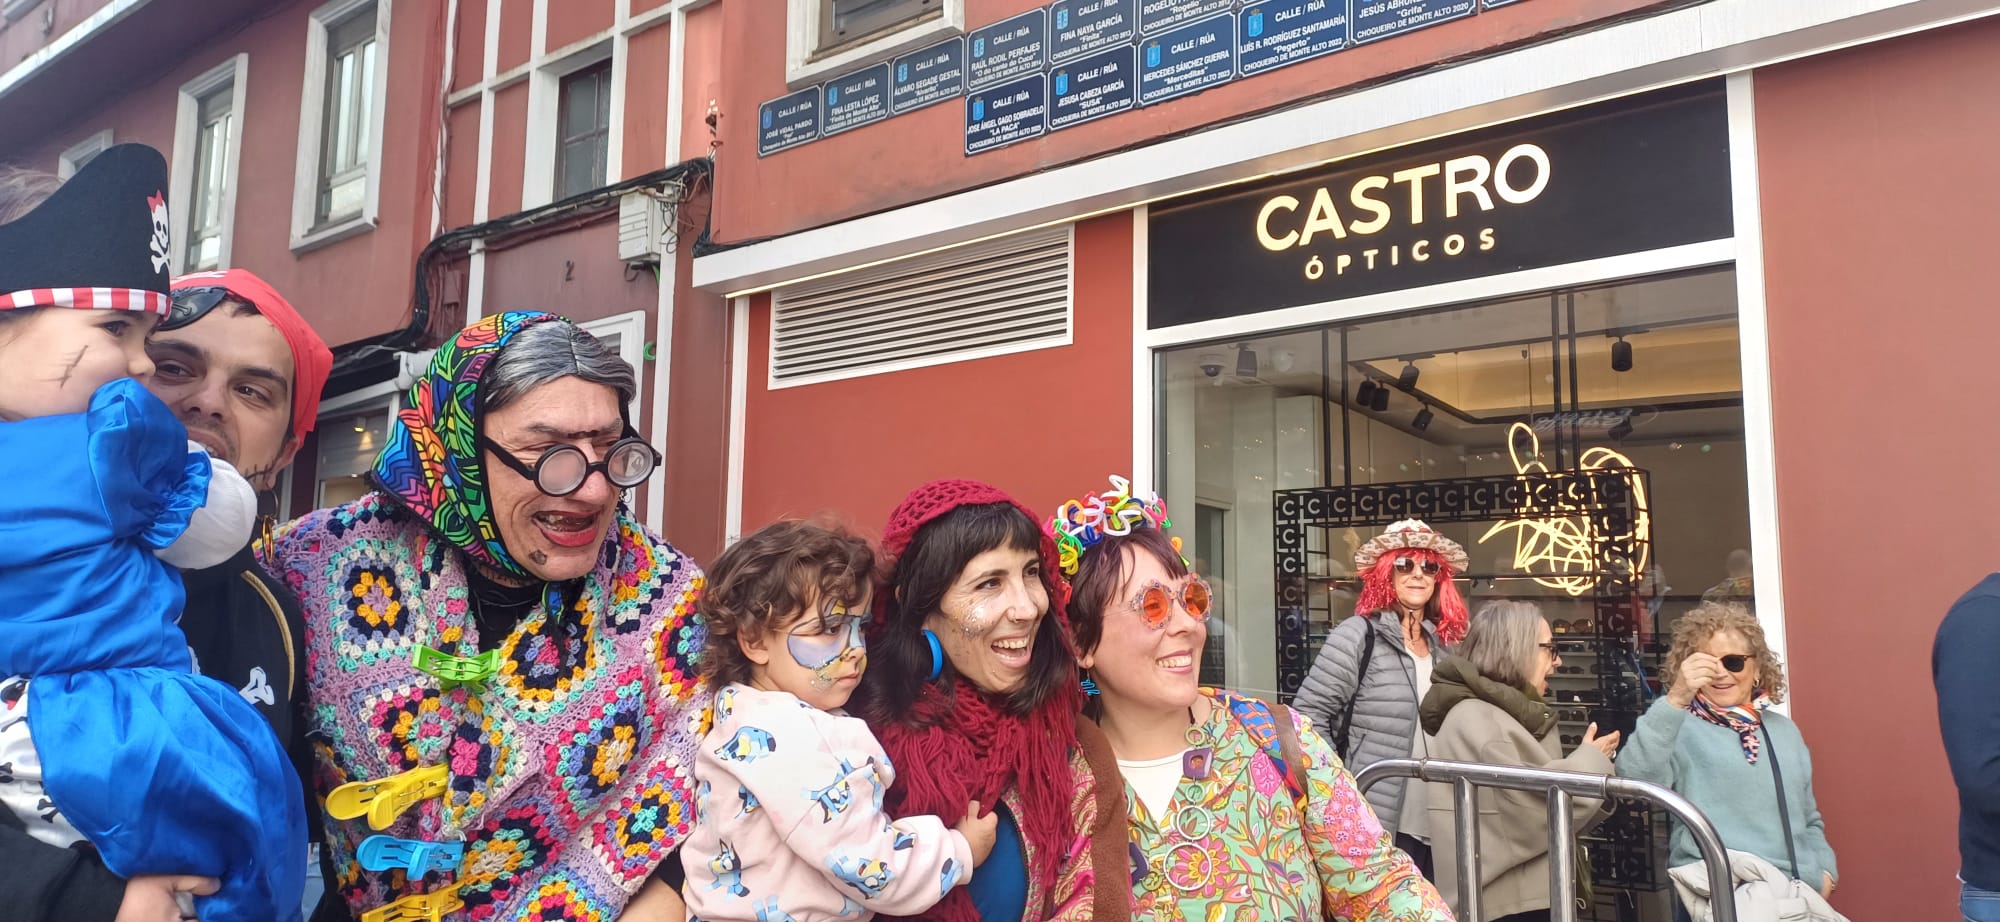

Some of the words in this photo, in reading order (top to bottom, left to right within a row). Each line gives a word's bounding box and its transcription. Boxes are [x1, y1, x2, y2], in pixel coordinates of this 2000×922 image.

[1078, 4, 1100, 16] CALLE
[1184, 7, 1202, 18] MONTE
[1203, 2, 1217, 11] ALTO
[1275, 7, 1301, 22] CALLE
[1359, 2, 1385, 18] JESÚS
[1396, 3, 1426, 17] "Grifa"
[1060, 31, 1076, 42] FINA
[1077, 24, 1095, 36] NAYA
[1096, 13, 1122, 30] GARCÍA
[1357, 22, 1396, 38] CHOQUEIRO
[1398, 18, 1407, 28] DE
[1408, 12, 1432, 24] MONTE
[1434, 8, 1452, 18] ALTO
[1453, 2, 1469, 13] 2020
[993, 32, 1012, 45] CALLE
[1017, 26, 1030, 37] RÚA
[1256, 40, 1262, 48] R.
[1263, 28, 1301, 46] RODRÍGUEZ
[1302, 14, 1345, 35] SANTAMARÍA
[1089, 38, 1105, 48] MONTE
[1107, 34, 1119, 42] ALTO
[1171, 39, 1194, 54] CALLE
[1200, 32, 1215, 45] RÚA
[1273, 37, 1310, 54] "Pegerto"
[916, 59, 933, 71] CALLE
[937, 53, 949, 64] RÚA
[971, 58, 987, 71] RAÚL
[989, 53, 1007, 65] RODIL
[1008, 42, 1040, 59] PERFAJES
[1244, 56, 1278, 71] CHOQUEIRO
[1280, 53, 1288, 61] DE
[1289, 46, 1310, 58] MONTE
[1312, 42, 1327, 52] ALTO
[1328, 38, 1342, 48] 2022
[1003, 66, 1018, 76] MONTE
[1019, 62, 1030, 71] ALTO
[1078, 68, 1098, 82] CALLE
[1104, 62, 1118, 74] RÚA
[1144, 66, 1175, 82] MERCEDES
[1176, 57, 1203, 72] SÁNCHEZ
[1204, 50, 1229, 64] GUERRA
[939, 69, 960, 81] GESTAL
[845, 85, 861, 94] CALLE
[865, 78, 876, 88] RÚA
[940, 88, 950, 96] ALTO
[1058, 94, 1079, 107] JESUSA
[1080, 87, 1102, 100] CABEZA
[1103, 79, 1124, 94] GARCÍA
[1143, 86, 1174, 100] CHOQUEIRA
[1183, 76, 1202, 88] MONTE
[1203, 73, 1217, 82] ALTO
[832, 106, 844, 116] FINA
[844, 100, 860, 112] LESTA
[861, 94, 879, 106] LÓPEZ
[993, 96, 1011, 109] CALLE
[1016, 90, 1029, 102] RÚA
[1079, 97, 1102, 109] "SUSA"
[778, 106, 796, 118] CALLE
[800, 102, 812, 110] RÚA
[1088, 105, 1105, 115] MONTE
[1106, 102, 1119, 110] ALTO
[795, 119, 812, 129] PARDO
[981, 119, 997, 130] ÁNGEL
[998, 115, 1012, 125] GAGO
[1256, 144, 1550, 251] CASTRO
[1305, 228, 1495, 280] ÓPTICOS
